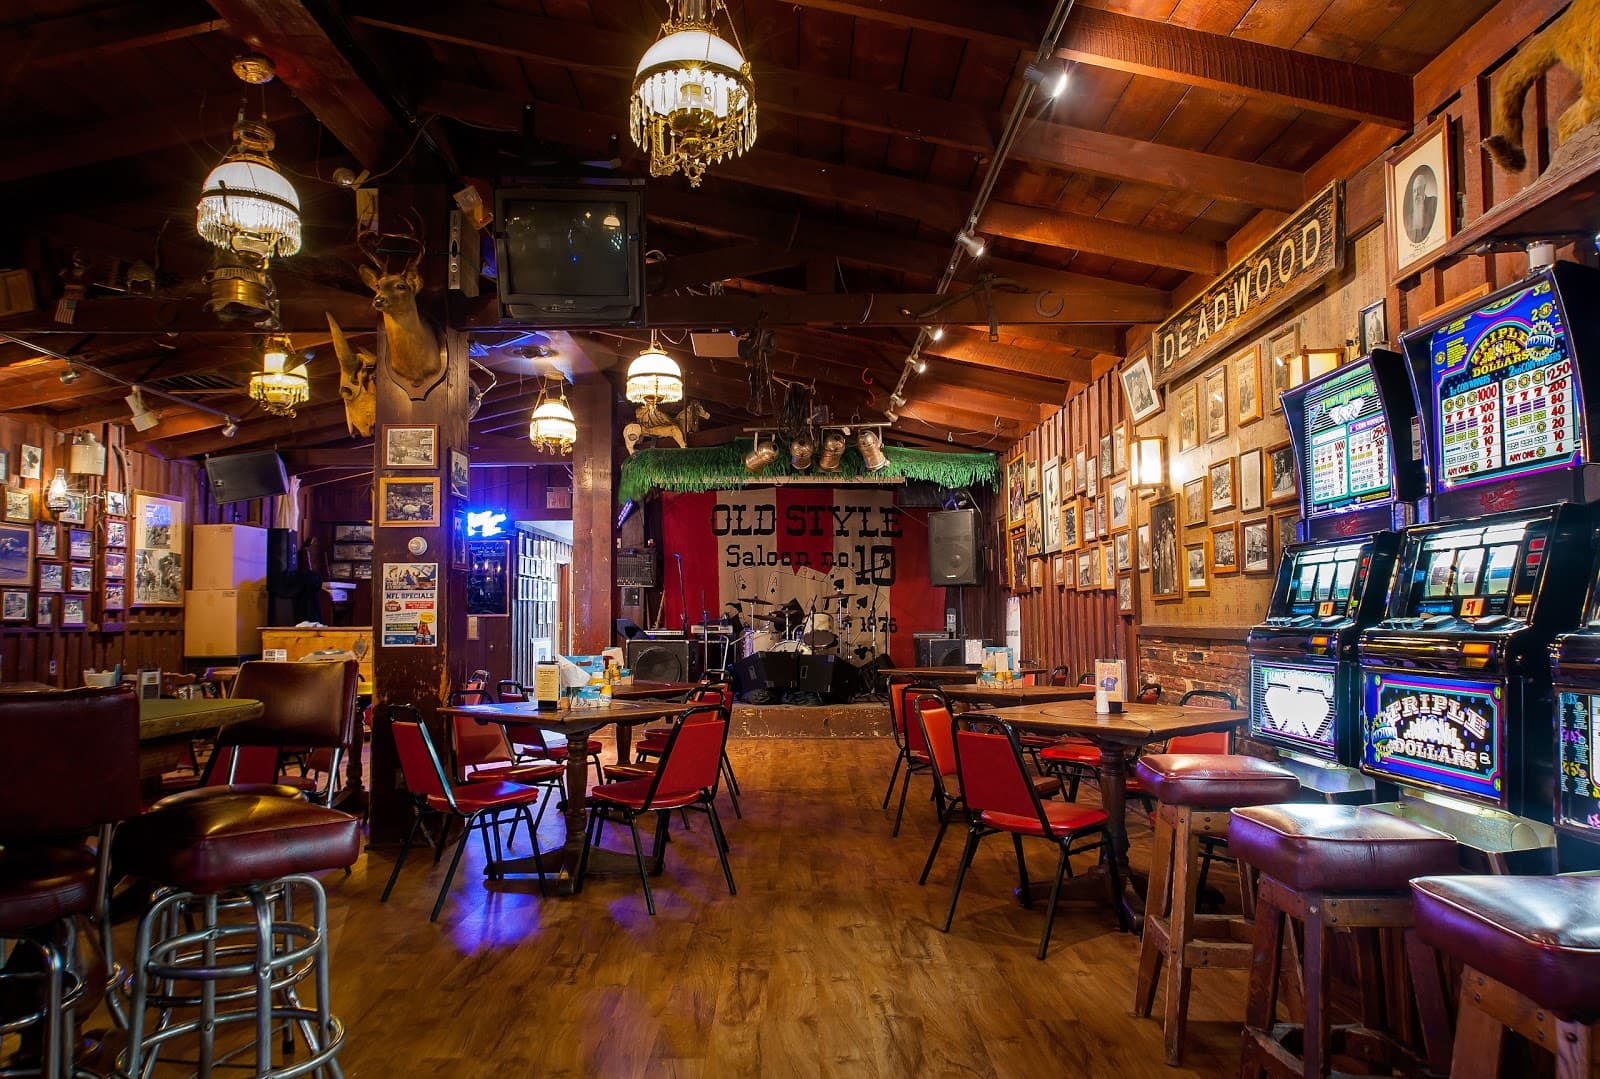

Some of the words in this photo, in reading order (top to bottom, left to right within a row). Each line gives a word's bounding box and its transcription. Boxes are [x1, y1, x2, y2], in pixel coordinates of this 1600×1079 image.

[1163, 218, 1321, 369] DEADWOOD
[1472, 350, 1531, 378] DOLLARS
[1477, 384, 1498, 402] 1000
[1480, 401, 1495, 413] 100
[1551, 404, 1565, 416] 40
[1481, 413, 1494, 424] 40
[1552, 417, 1565, 429] 20
[1482, 424, 1494, 436] 20
[1553, 430, 1564, 441] 10
[1484, 435, 1494, 446] 10
[1486, 447, 1492, 457] 5
[1556, 442, 1563, 452] 4
[1509, 451, 1522, 462] ANY
[1522, 449, 1535, 460] ONE
[1447, 465, 1458, 476] ANY
[1458, 463, 1469, 474] ONE
[1486, 459, 1493, 468] 2
[710, 504, 776, 537] OLD
[785, 504, 903, 538] STYLE
[726, 544, 812, 568] Saloon
[1385, 693, 1488, 740] TRIPLE
[1393, 738, 1478, 770] DOLLARS
